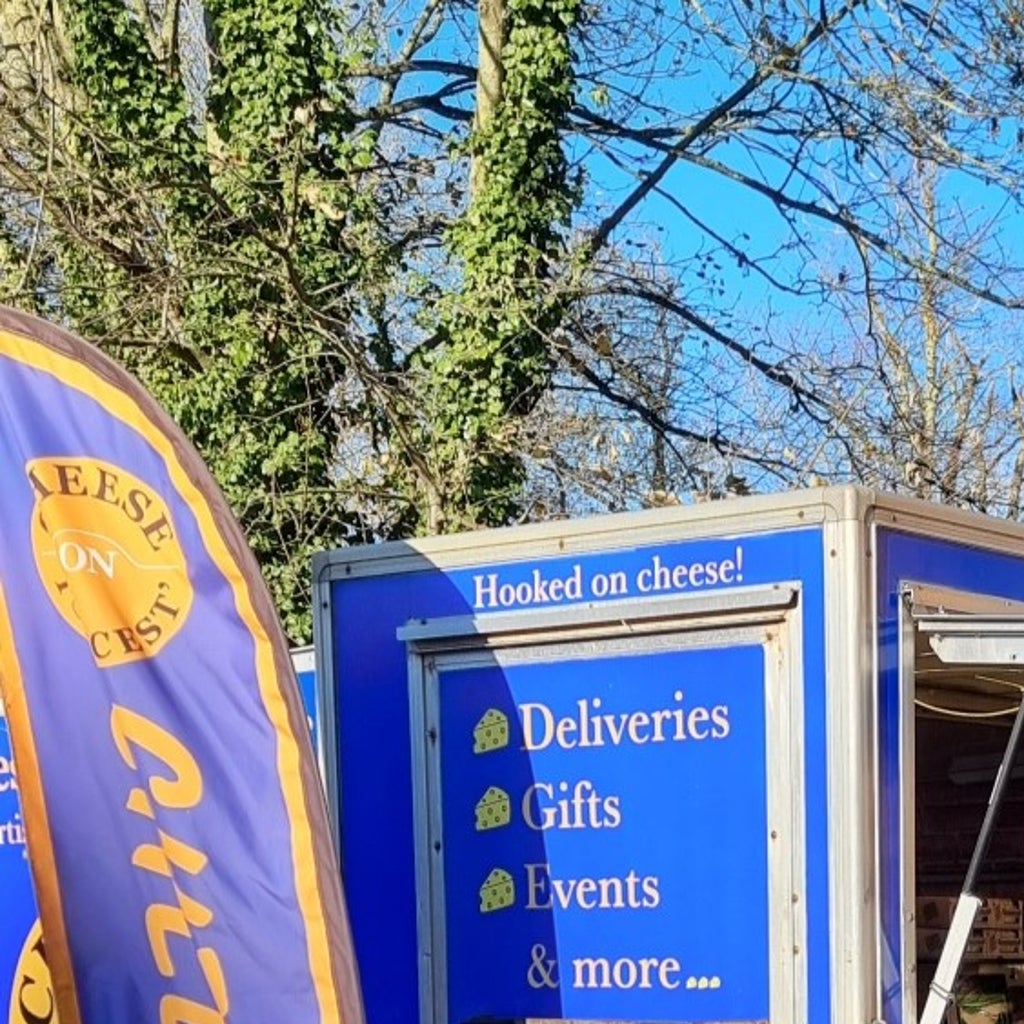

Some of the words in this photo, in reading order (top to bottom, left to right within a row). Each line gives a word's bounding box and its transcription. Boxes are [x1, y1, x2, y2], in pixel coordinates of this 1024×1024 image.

[28, 463, 174, 552] EESE
[58, 541, 116, 580] ON
[473, 564, 582, 609] Hooked
[590, 570, 628, 597] on
[636, 545, 744, 593] cheese!
[518, 690, 730, 751] Deliveries
[521, 780, 622, 831] Gifts
[523, 863, 661, 910] Events
[526, 943, 560, 989] &
